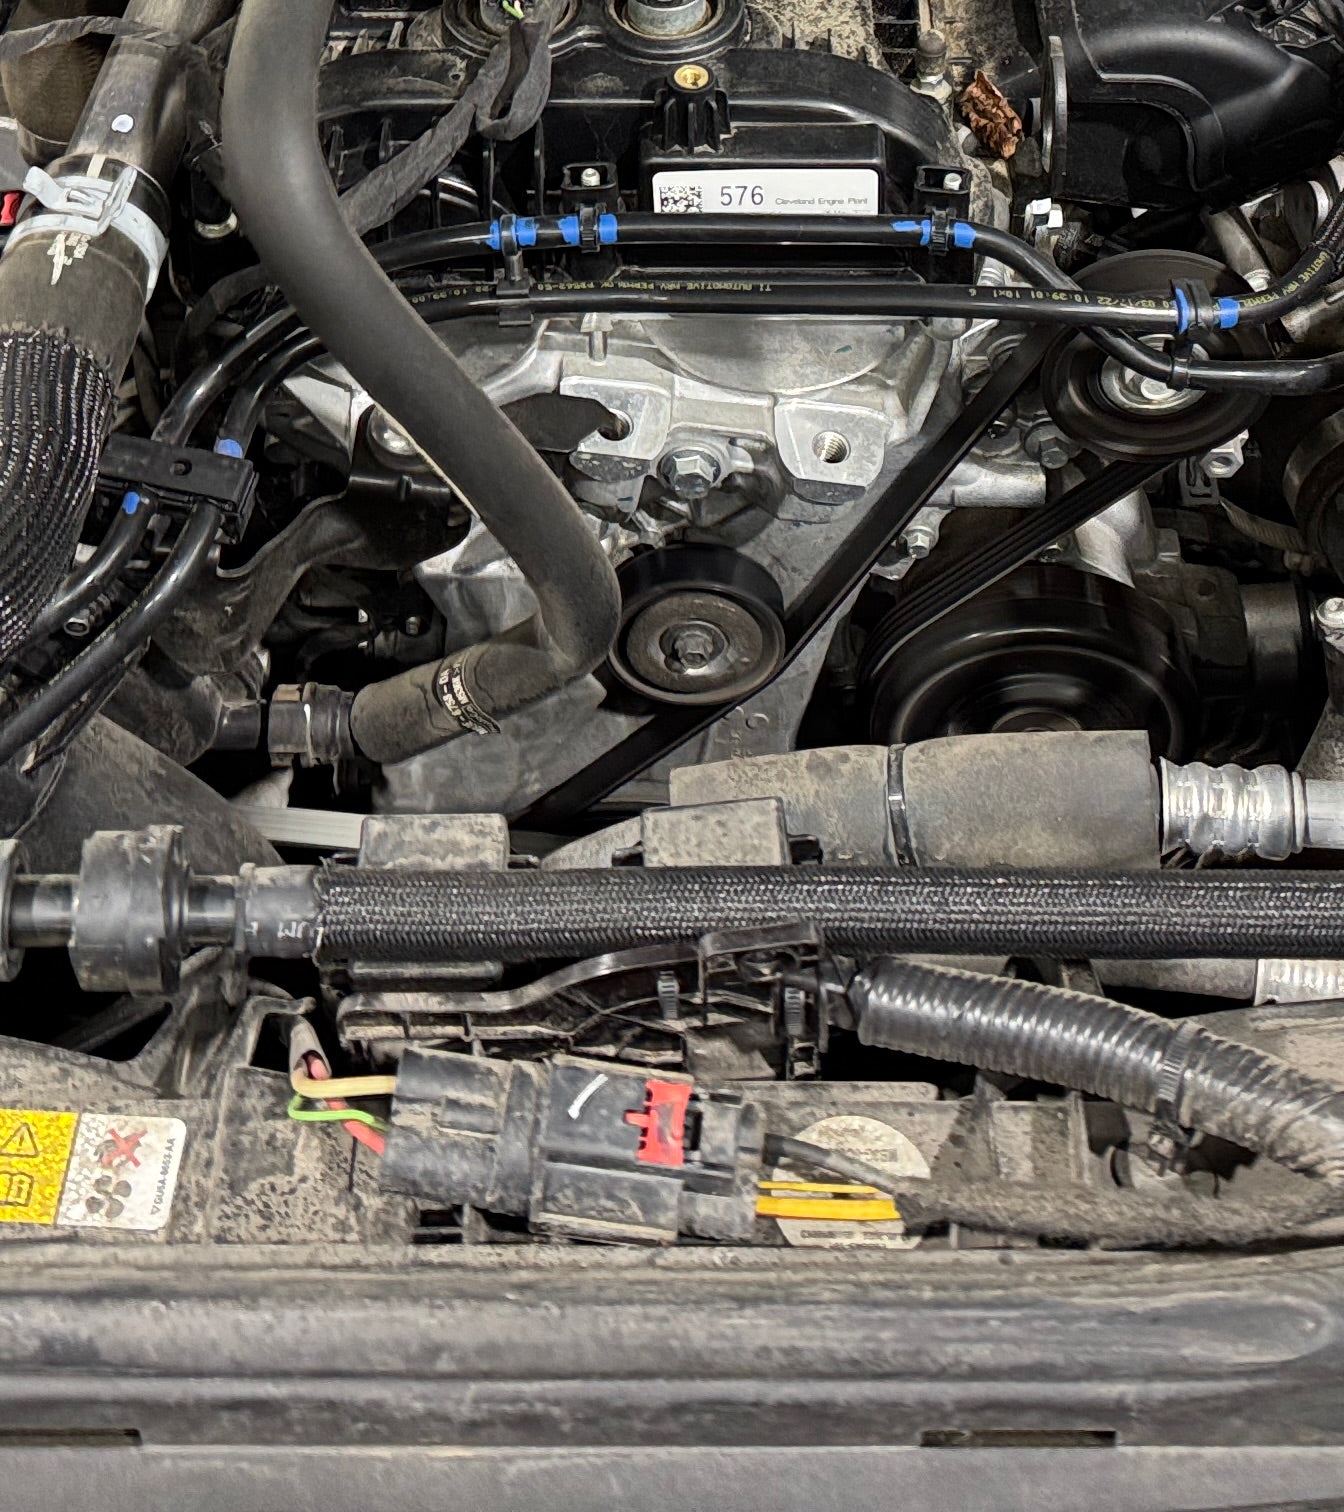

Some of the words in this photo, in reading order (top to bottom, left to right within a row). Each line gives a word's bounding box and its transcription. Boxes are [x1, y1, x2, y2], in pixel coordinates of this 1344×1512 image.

[719, 185, 765, 207] 576
[774, 196, 815, 206] Cleveland
[817, 197, 845, 207] Engine
[847, 196, 868, 206] Plant
